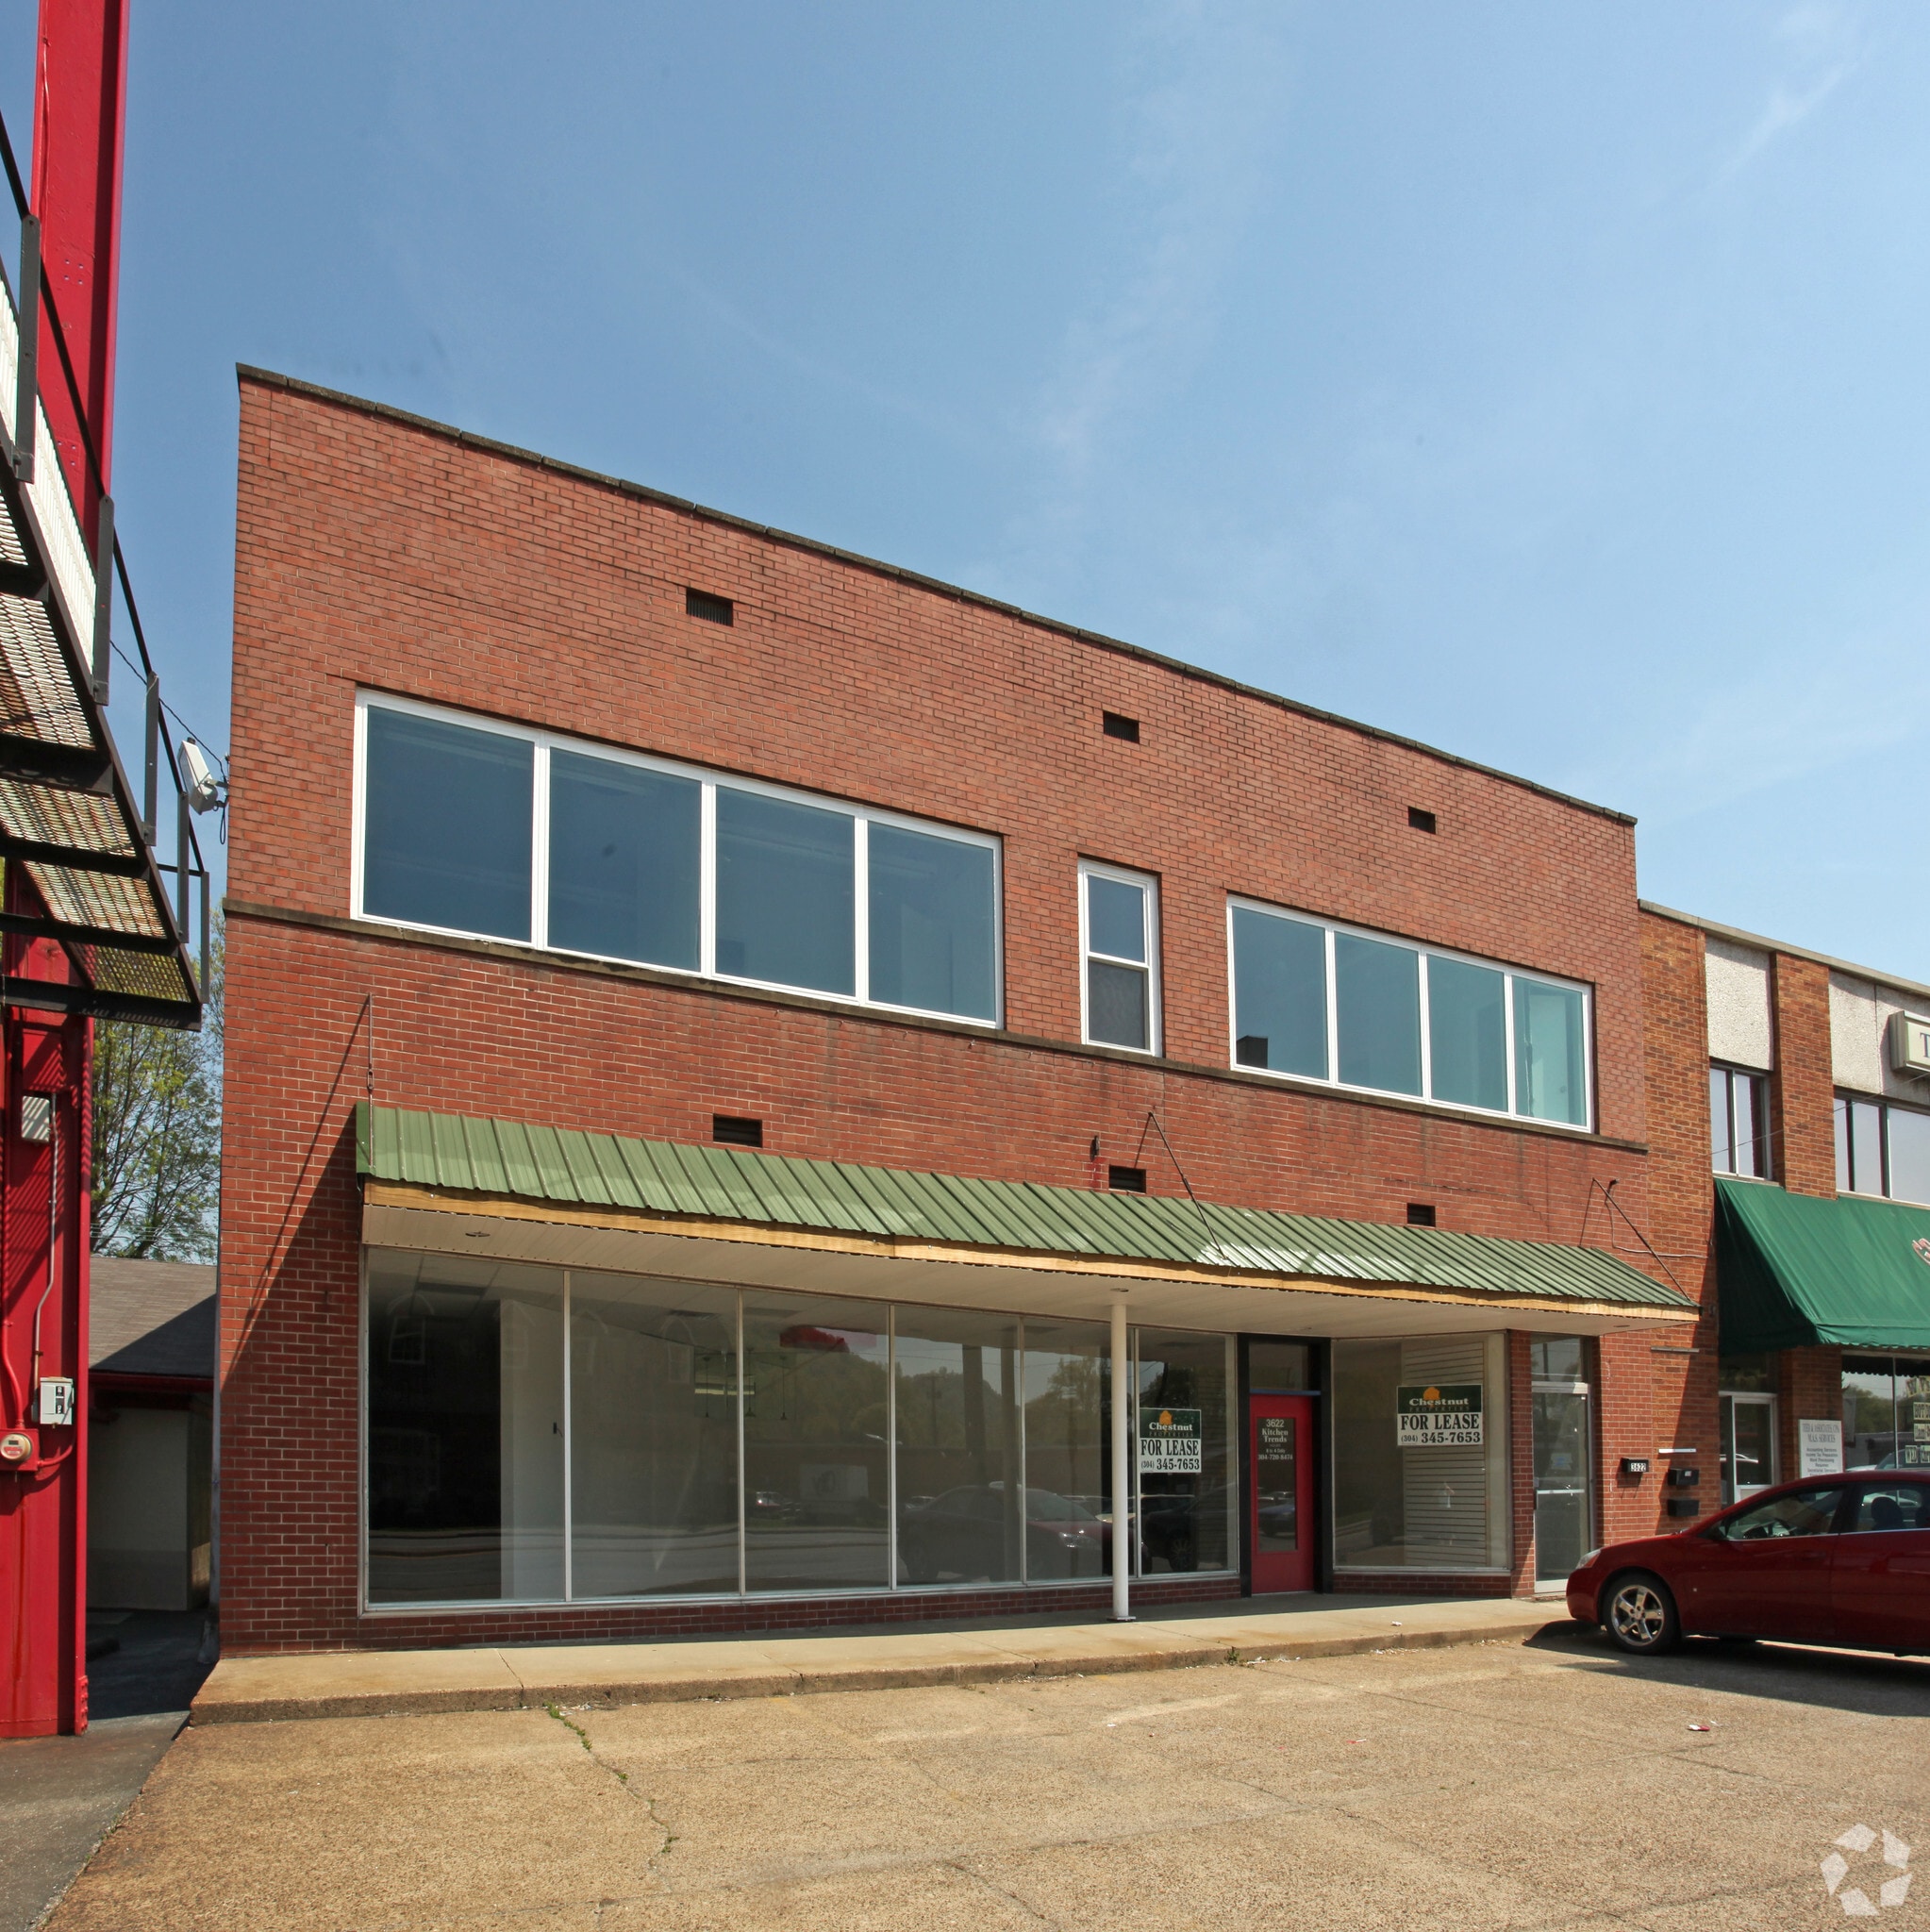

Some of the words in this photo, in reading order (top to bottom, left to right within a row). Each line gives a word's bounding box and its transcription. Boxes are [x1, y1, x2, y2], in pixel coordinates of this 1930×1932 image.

[1409, 1398, 1469, 1406] Chestnut
[1149, 1422, 1193, 1431] Chestnut
[1266, 1419, 1284, 1427] 3622
[1401, 1415, 1428, 1430] FOR
[1435, 1414, 1479, 1430] LEASE
[1421, 1432, 1480, 1443] 345-7653
[1141, 1439, 1162, 1456] FOR
[1166, 1440, 1199, 1456] LEASE
[1141, 1461, 1154, 1469] (304)
[1157, 1458, 1200, 1470] 345-7653
[1631, 1463, 1646, 1472] 3622
